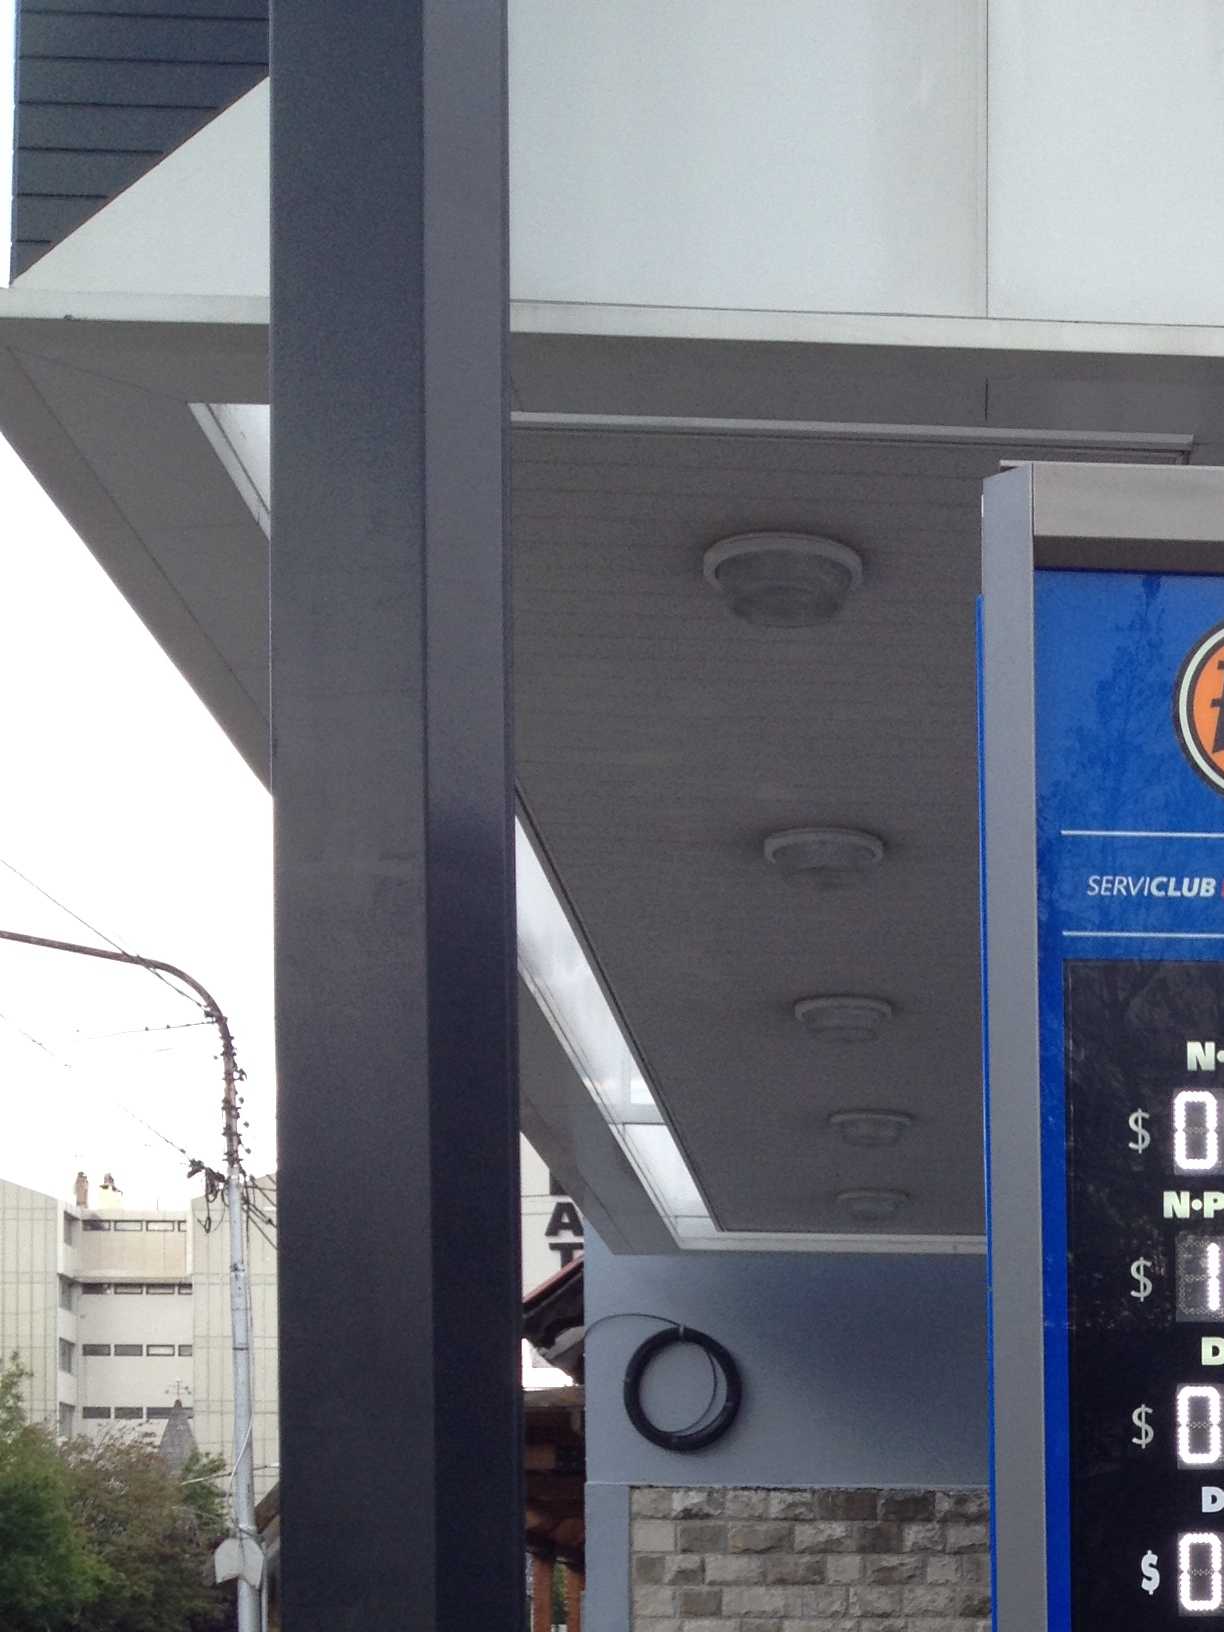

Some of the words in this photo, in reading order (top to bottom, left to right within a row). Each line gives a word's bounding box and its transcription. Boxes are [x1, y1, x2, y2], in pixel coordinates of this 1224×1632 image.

[1087, 875, 1216, 897] SERVICLUB
[1128, 1108, 1151, 1154] $
[1130, 1256, 1153, 1302] $
[1131, 1404, 1154, 1449] $
[1140, 1549, 1161, 1596] $
